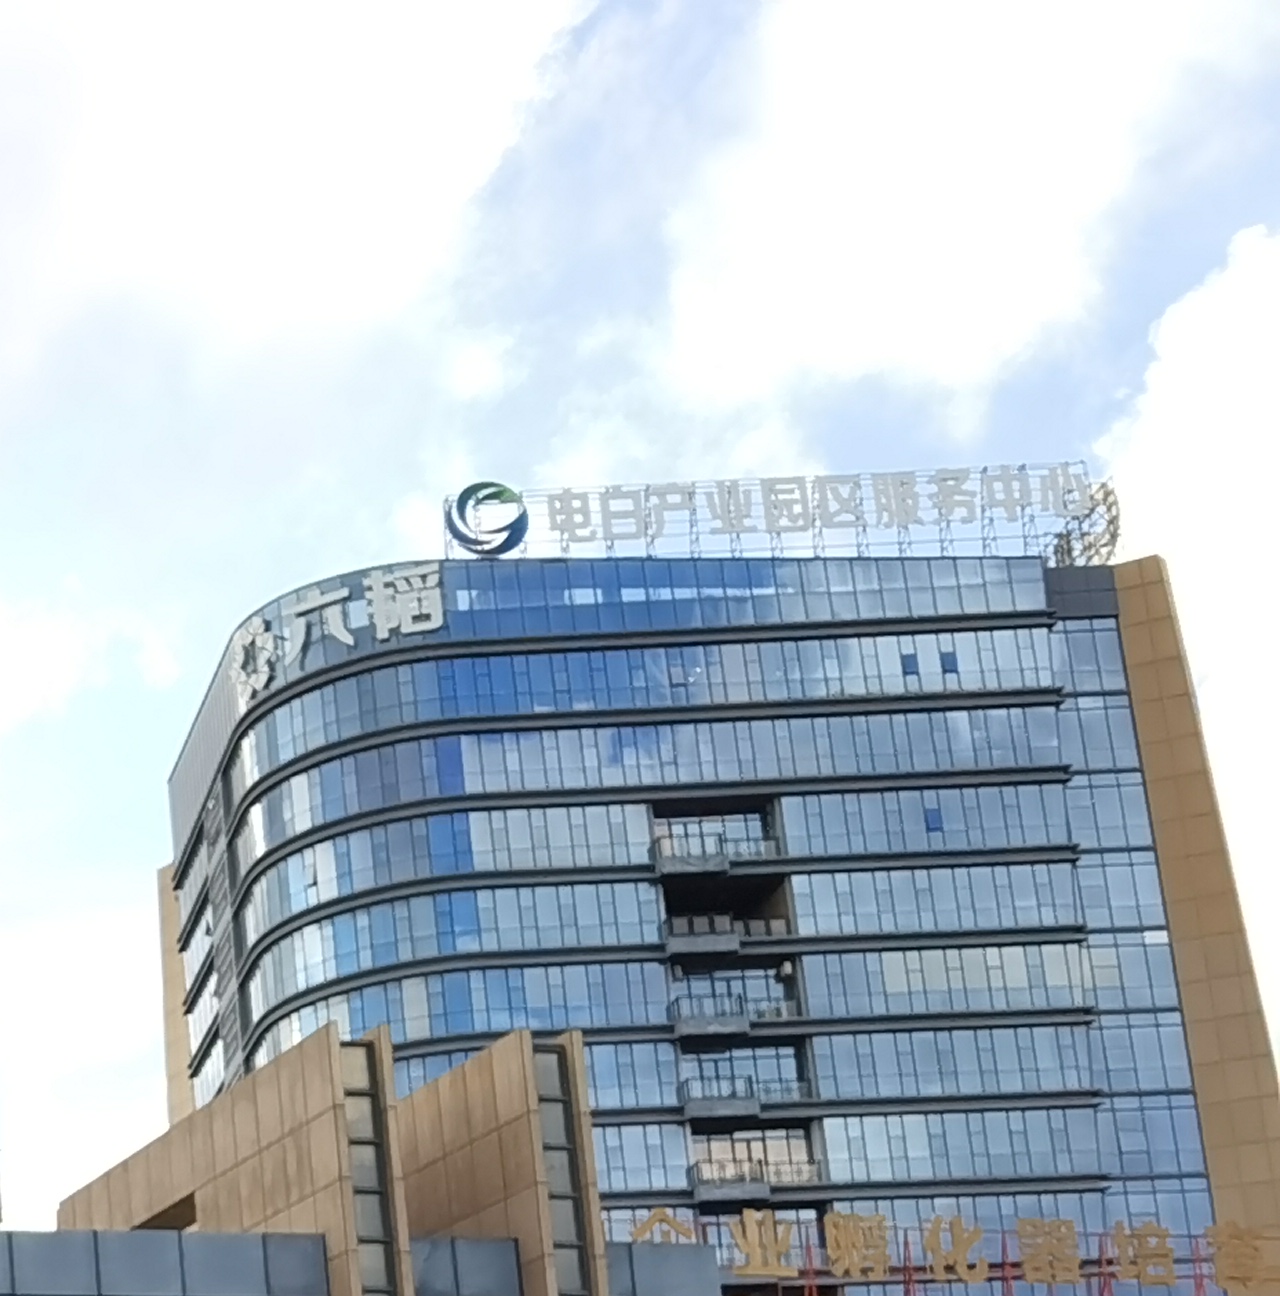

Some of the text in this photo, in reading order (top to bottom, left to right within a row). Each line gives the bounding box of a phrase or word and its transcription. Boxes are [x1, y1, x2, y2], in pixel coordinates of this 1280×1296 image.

[547, 462, 1093, 541] 电白产业园区服务中心
[282, 562, 443, 666] 六韬
